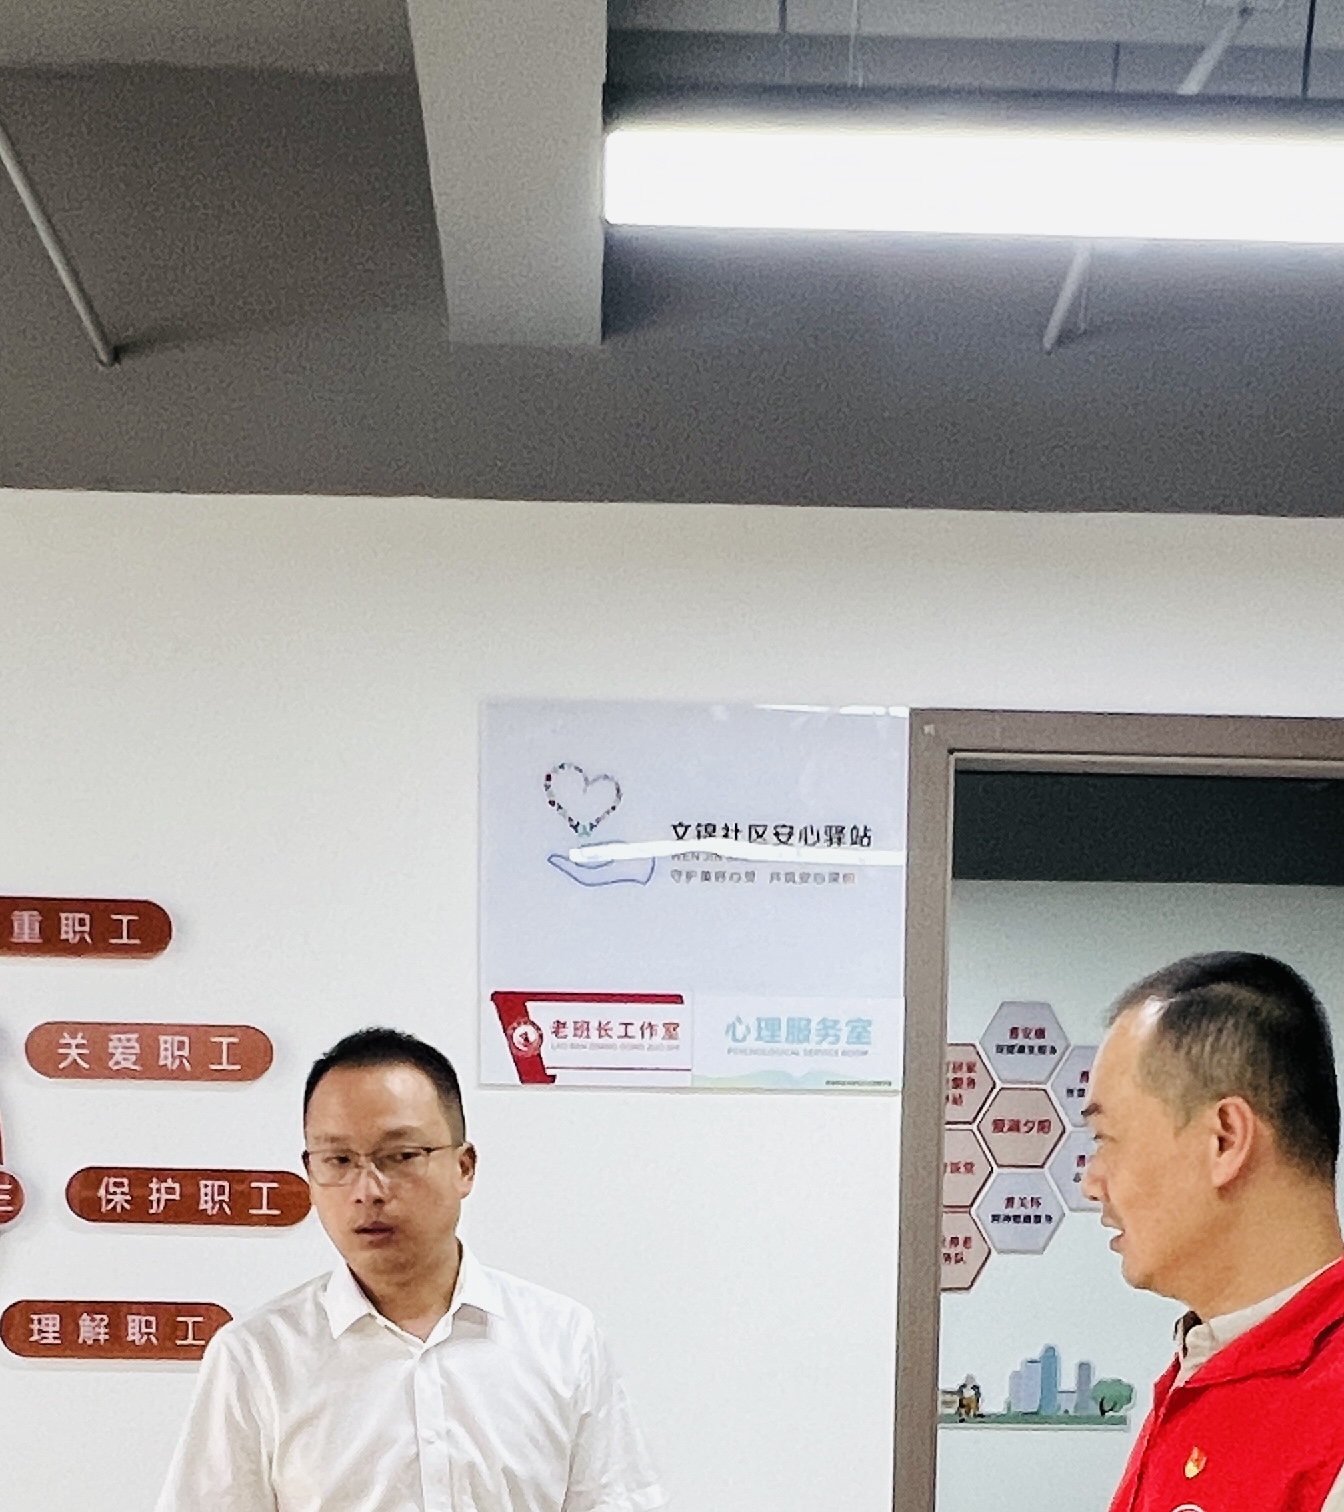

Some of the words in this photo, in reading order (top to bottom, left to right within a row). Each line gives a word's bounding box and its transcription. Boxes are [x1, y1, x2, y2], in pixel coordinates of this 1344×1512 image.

[551, 1020, 681, 1041] 老班长工作室
[725, 1015, 873, 1046] 心理服务室
[56, 1032, 243, 1073] 关爱职工
[97, 1176, 283, 1216] 保护职工
[28, 1312, 208, 1345] 理解职工
